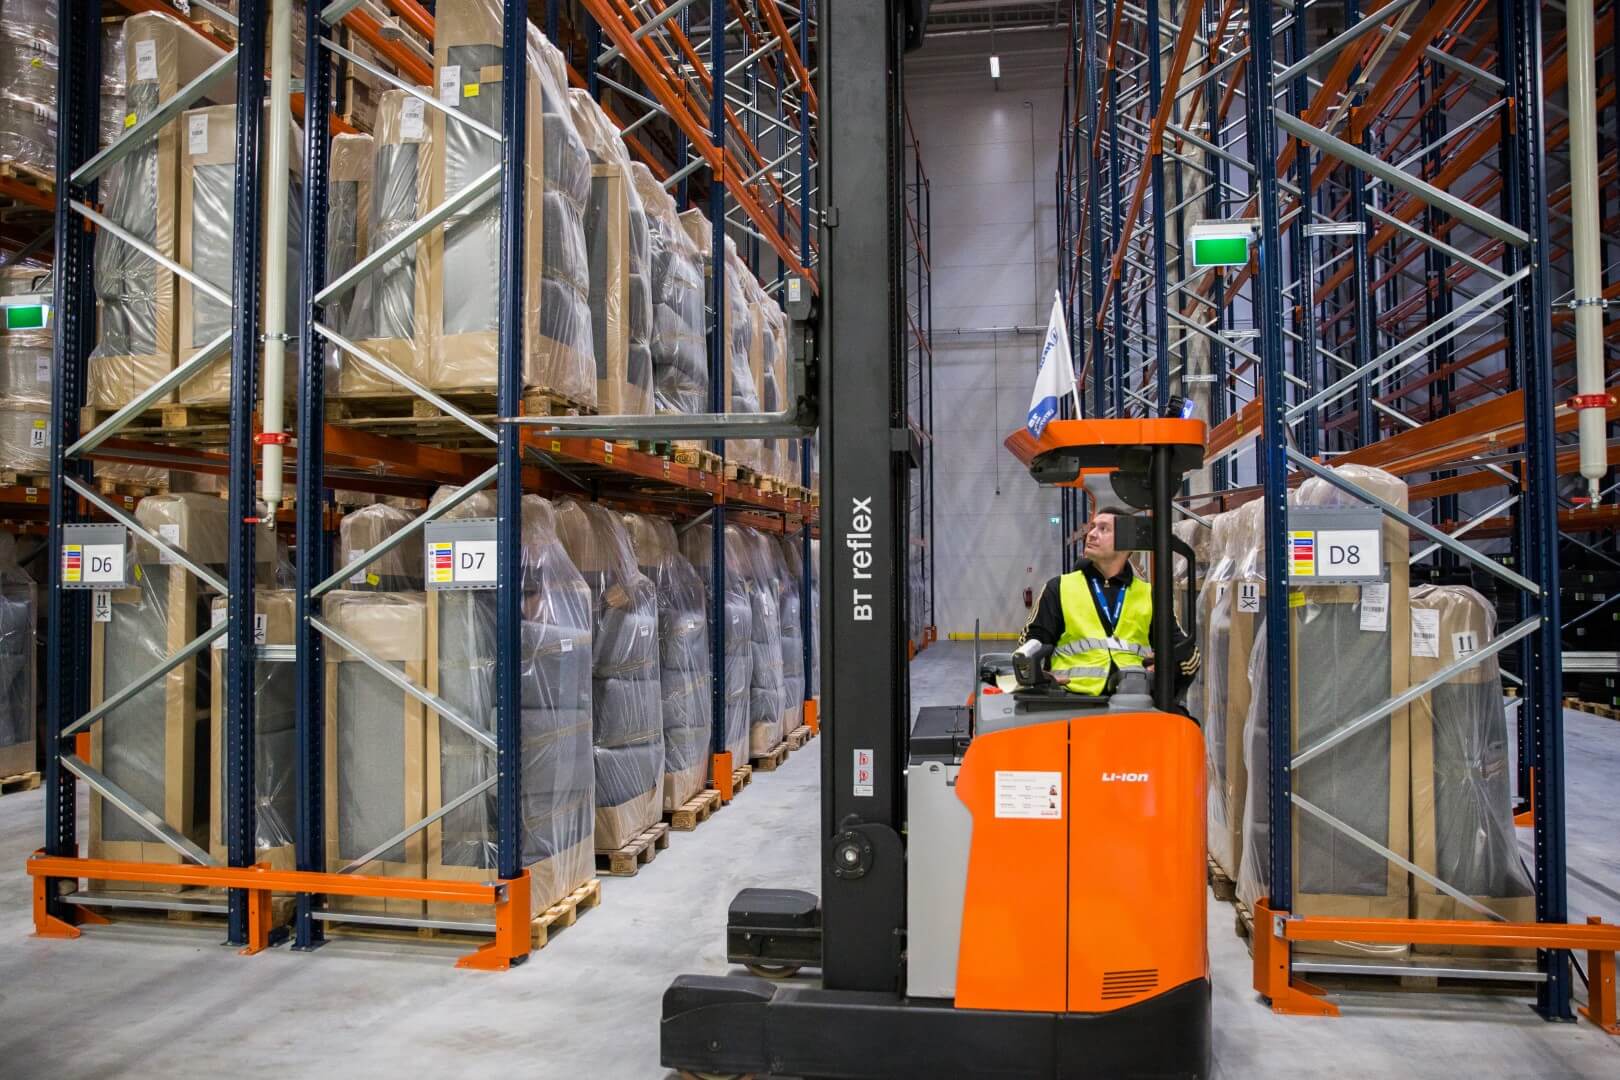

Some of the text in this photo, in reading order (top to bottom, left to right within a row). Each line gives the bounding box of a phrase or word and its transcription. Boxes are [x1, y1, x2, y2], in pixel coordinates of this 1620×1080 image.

[461, 552, 485, 569] D7
[847, 496, 873, 621] BT reflex
[1330, 545, 1361, 565] D8
[91, 556, 112, 573] D6
